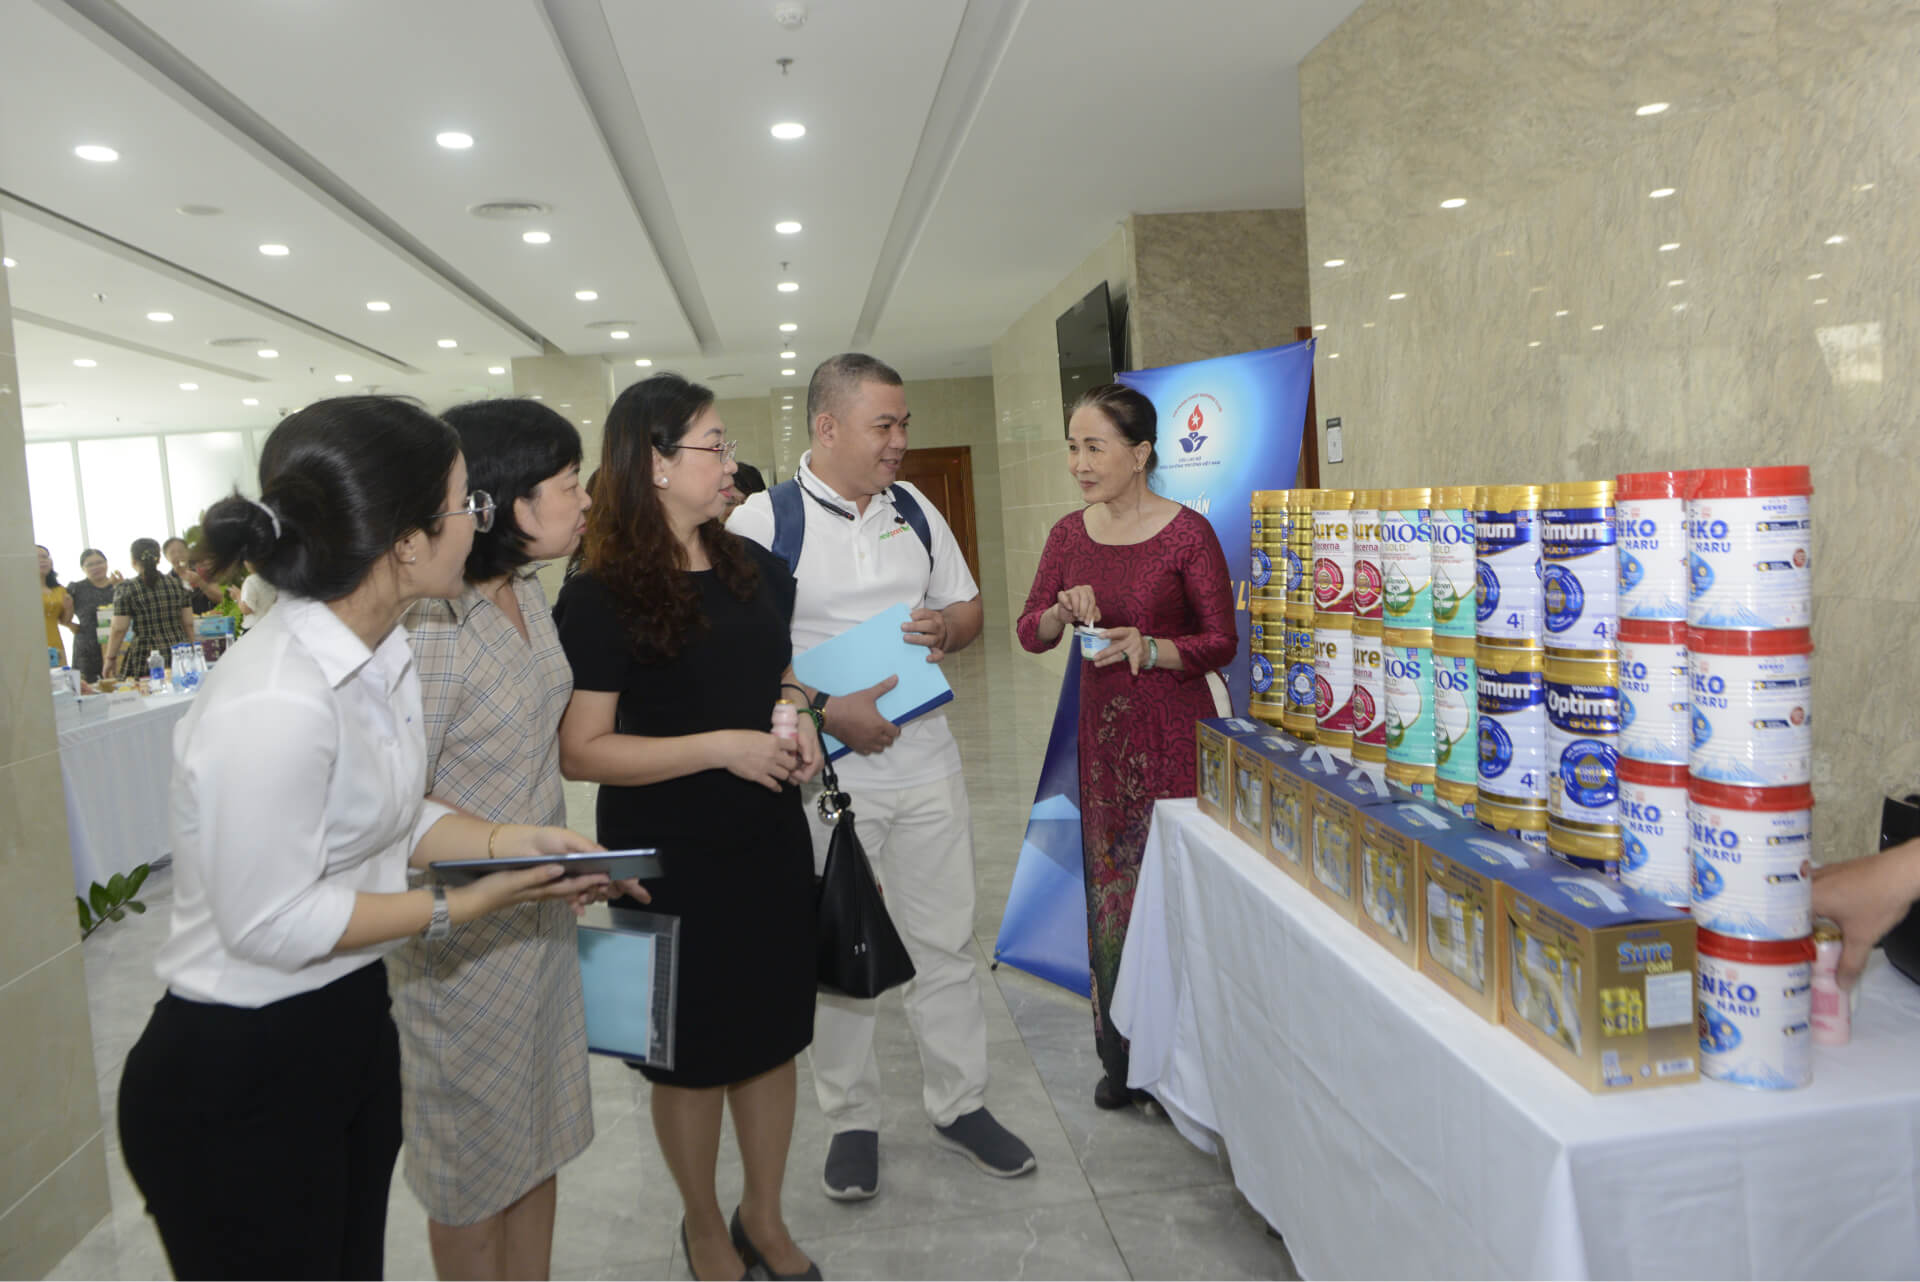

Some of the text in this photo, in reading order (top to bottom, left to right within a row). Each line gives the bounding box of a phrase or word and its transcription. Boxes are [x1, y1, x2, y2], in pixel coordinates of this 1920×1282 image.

[1507, 612, 1520, 629] 4
[1593, 622, 1608, 639] 4
[1519, 772, 1534, 788] 4
[1617, 941, 1673, 966] Sure
